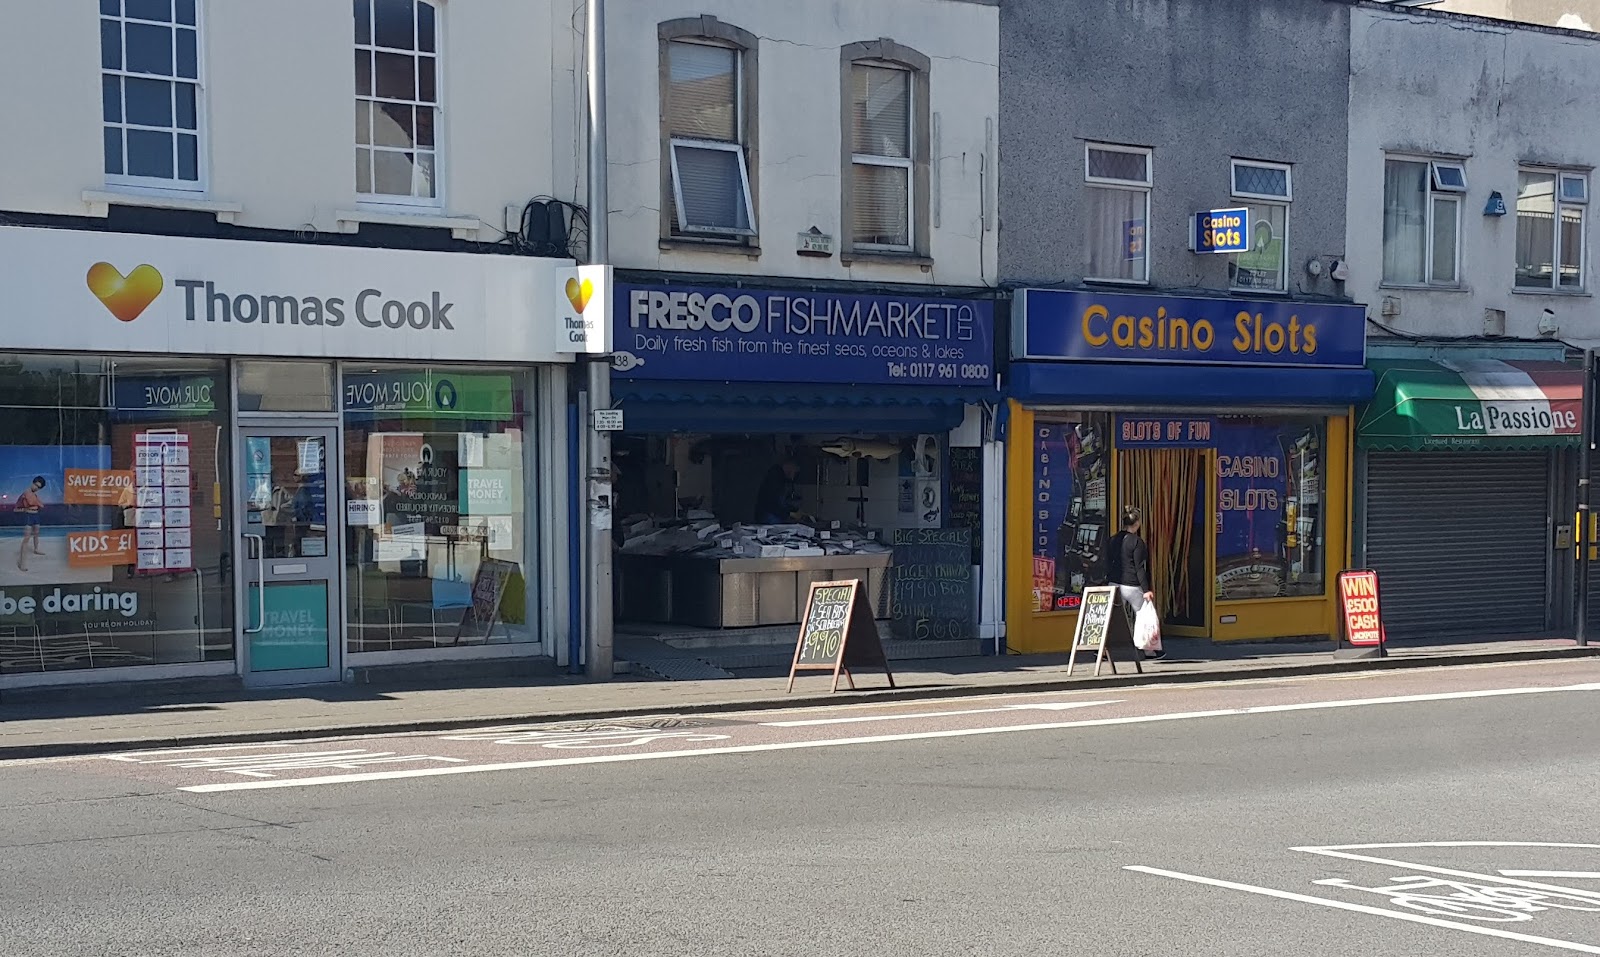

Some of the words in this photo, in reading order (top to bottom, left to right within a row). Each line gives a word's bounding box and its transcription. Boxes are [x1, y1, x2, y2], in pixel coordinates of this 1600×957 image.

[1203, 215, 1241, 229] Casino
[1203, 229, 1241, 247] Slots
[175, 279, 345, 327] Thomas
[355, 288, 455, 330] Cook
[564, 317, 593, 329] Thomas
[630, 290, 761, 332] FRESCO
[767, 296, 957, 340] FISHMARKET
[957, 304, 973, 341] LTD
[569, 330, 588, 342] Cook
[1081, 304, 1215, 351] Casino
[1232, 310, 1318, 356] Slots
[635, 333, 668, 354] Daily
[674, 335, 707, 351] fresh
[712, 336, 734, 352] fish
[738, 337, 767, 354] from
[772, 338, 793, 355] the
[798, 340, 830, 356] finest
[835, 343, 867, 358] seas,
[872, 345, 917, 358] oceans
[922, 343, 931, 358] &
[935, 345, 964, 359] lakes
[887, 362, 907, 377] Tel:
[909, 363, 935, 378] 0117
[938, 364, 957, 378] 961
[961, 364, 989, 379] 0800
[1455, 406, 1483, 430] La
[1487, 406, 1577, 430] Passione
[1122, 421, 1161, 441] SLOTS
[1167, 422, 1182, 440] OF
[1188, 421, 1211, 440] FUN
[1216, 456, 1279, 478] CASINO
[67, 474, 97, 487] SAVE
[100, 475, 130, 487] £200
[468, 478, 504, 488] TRAVEL
[468, 489, 504, 499] MONEY
[1220, 488, 1279, 511] SLOTS
[349, 502, 376, 512] HIRING
[70, 534, 110, 553] KIDS
[117, 533, 132, 551] £1
[894, 528, 913, 544] BIG
[917, 527, 969, 545] SPECIALS
[895, 564, 933, 579] TIGER
[1343, 577, 1373, 596] WIN
[0, 590, 37, 616] be
[42, 586, 138, 617] daring
[1057, 597, 1081, 607] OPEN
[1347, 598, 1377, 613] £500
[110, 621, 122, 629] ON
[123, 619, 153, 628] HOLIDAY
[265, 608, 314, 624] TRAVEL
[1349, 615, 1378, 631] CASH
[262, 623, 314, 638] MONEY
